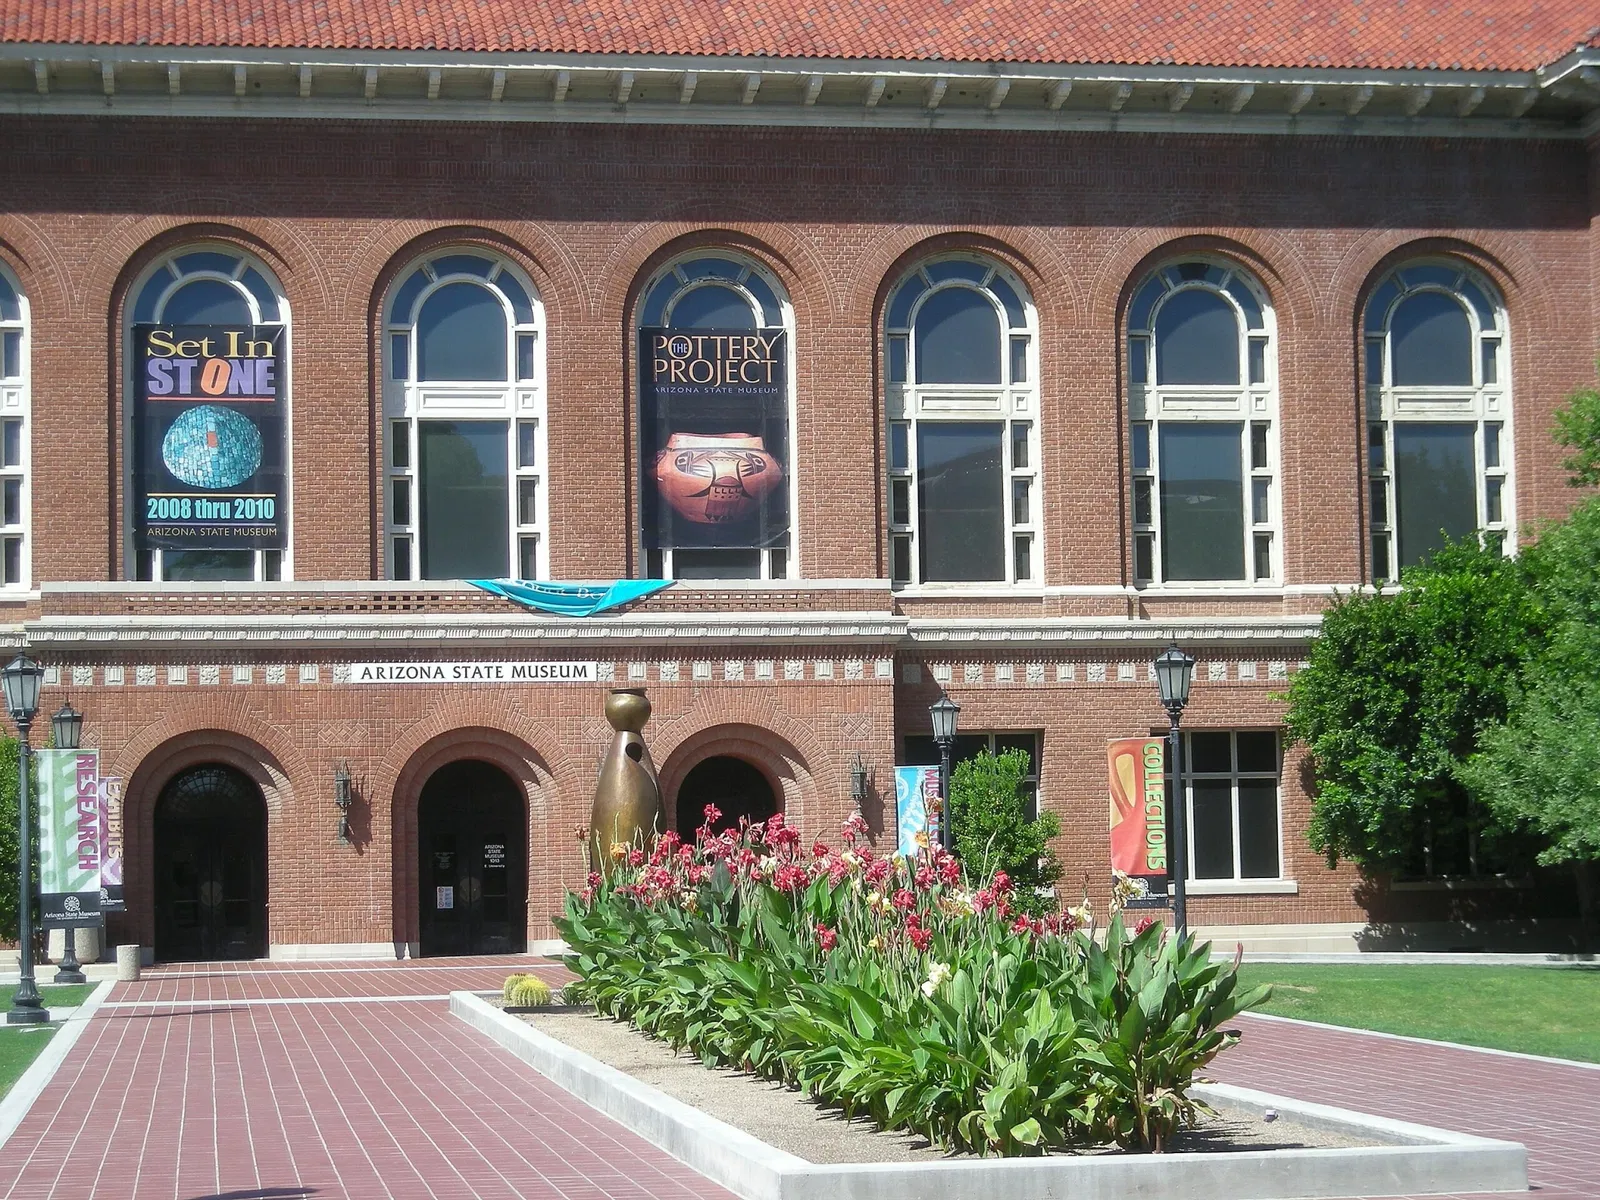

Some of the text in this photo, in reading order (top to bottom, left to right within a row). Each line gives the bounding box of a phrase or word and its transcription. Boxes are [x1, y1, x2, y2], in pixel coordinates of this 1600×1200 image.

[147, 330, 276, 358] Set In
[653, 335, 777, 359] POTTERY
[672, 343, 688, 354] THE
[147, 358, 276, 395] STONE
[653, 359, 778, 387] PROJECT
[147, 498, 275, 519] 2008 thru 2010
[147, 527, 277, 536] ARIZONA STATE MUSEUM
[360, 665, 588, 680] ARIZONA STATE MUSEUM
[76, 753, 99, 870] RESEARCH
[106, 781, 124, 859] EXHIBITS
[1142, 742, 1167, 871] COLLECTIONS
